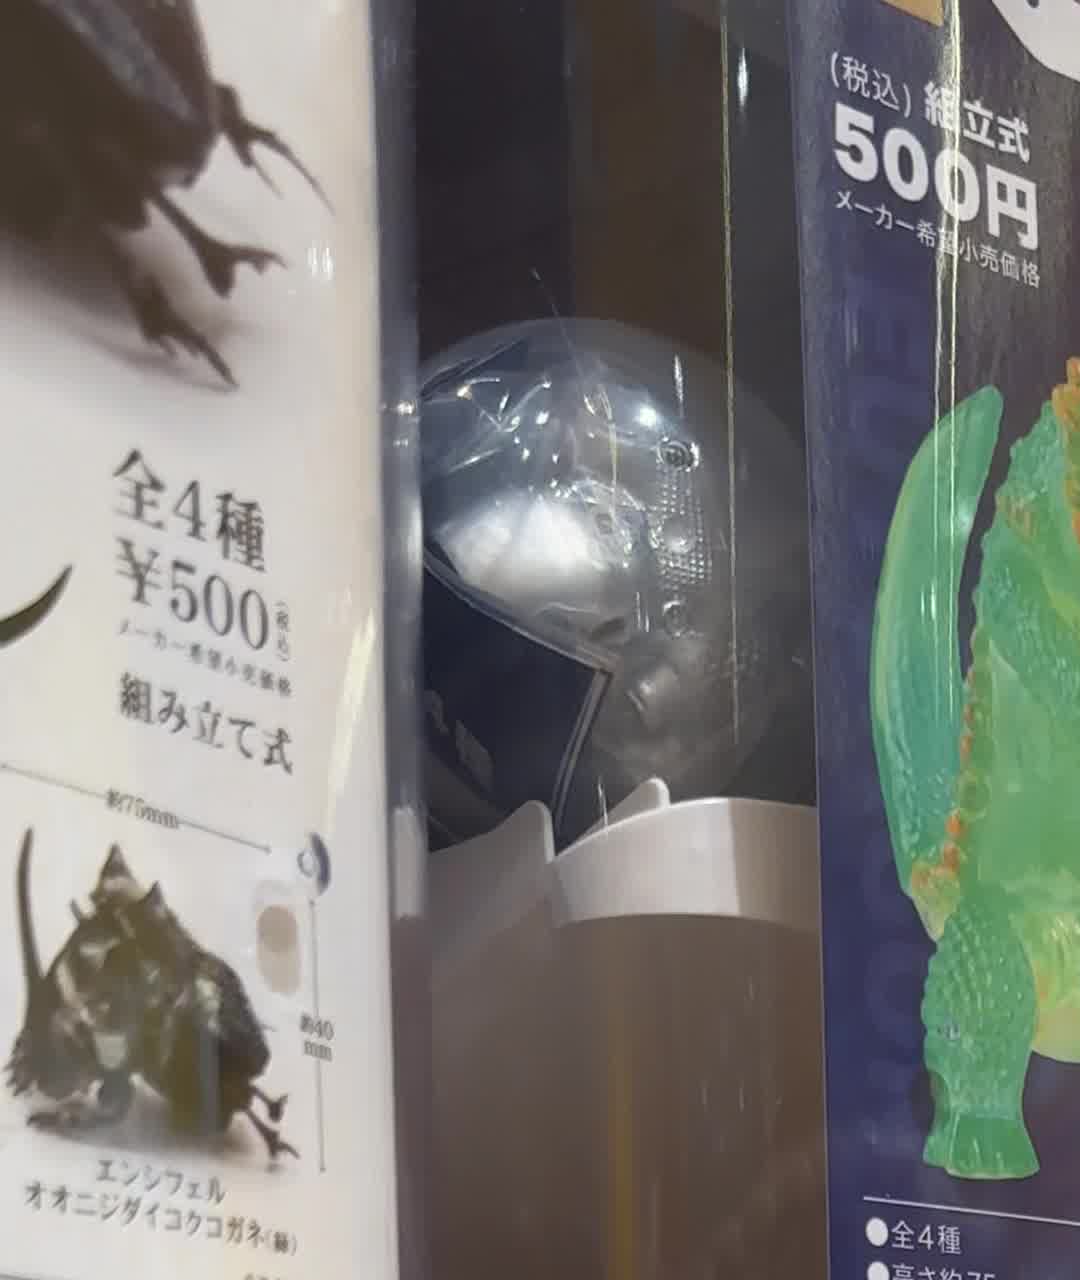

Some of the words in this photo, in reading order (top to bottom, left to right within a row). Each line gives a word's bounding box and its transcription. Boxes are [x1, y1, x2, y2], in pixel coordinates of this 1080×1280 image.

[922, 82, 1031, 164] 組立式
[833, 102, 1039, 251] 500円
[835, 189, 1041, 288] メーカー希望小売価格
[112, 447, 267, 573] 全4種
[115, 536, 270, 652] ¥500
[118, 671, 293, 775] 組み立て式
[891, 1218, 961, 1256] 全4種
